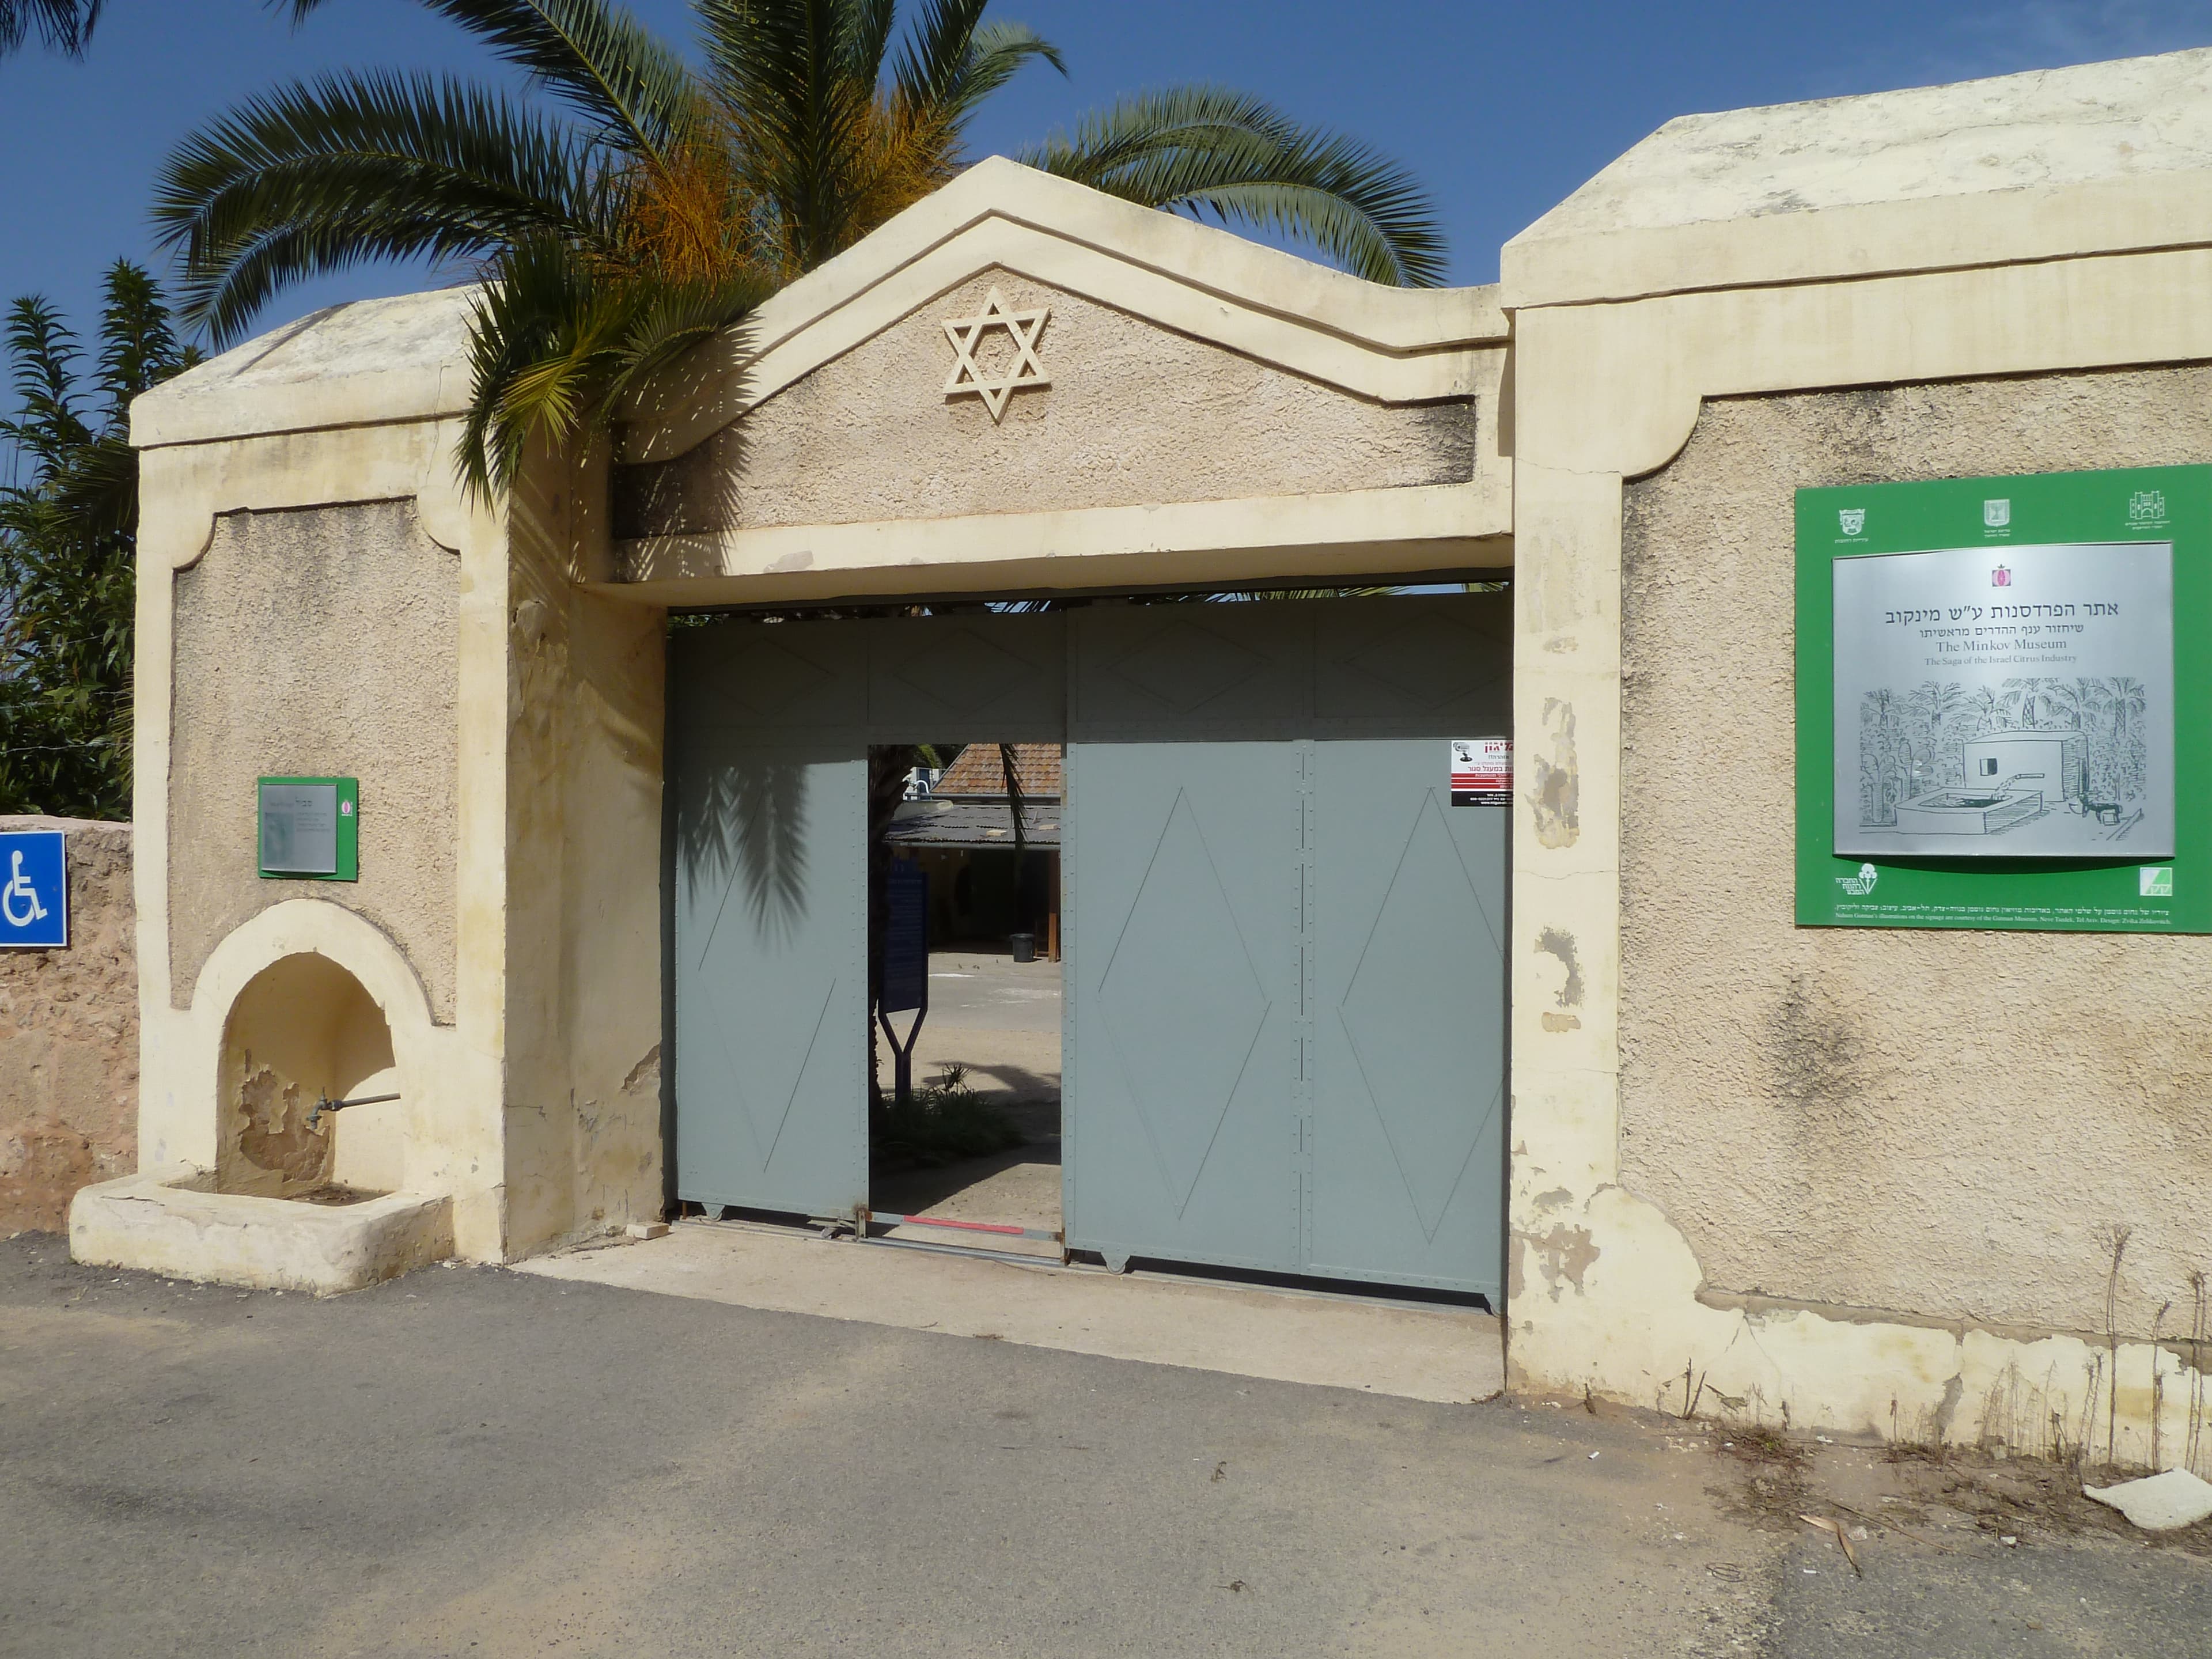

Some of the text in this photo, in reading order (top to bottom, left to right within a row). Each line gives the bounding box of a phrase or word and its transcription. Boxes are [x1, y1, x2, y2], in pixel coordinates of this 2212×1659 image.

[1991, 604, 2075, 619] הפרדסנות
[2083, 603, 2119, 616] אתר
[1885, 609, 1941, 626] מינקוב
[1919, 624, 2084, 638] שיחזור ענף ההדרים מראשיתו
[1936, 639, 2067, 652] The Minkov Museum
[1942, 657, 1962, 666] Saga
[1974, 656, 1987, 664] the
[1989, 655, 2012, 664] Israel
[2013, 654, 2040, 663] Citrus
[2041, 654, 2078, 664] Industry
